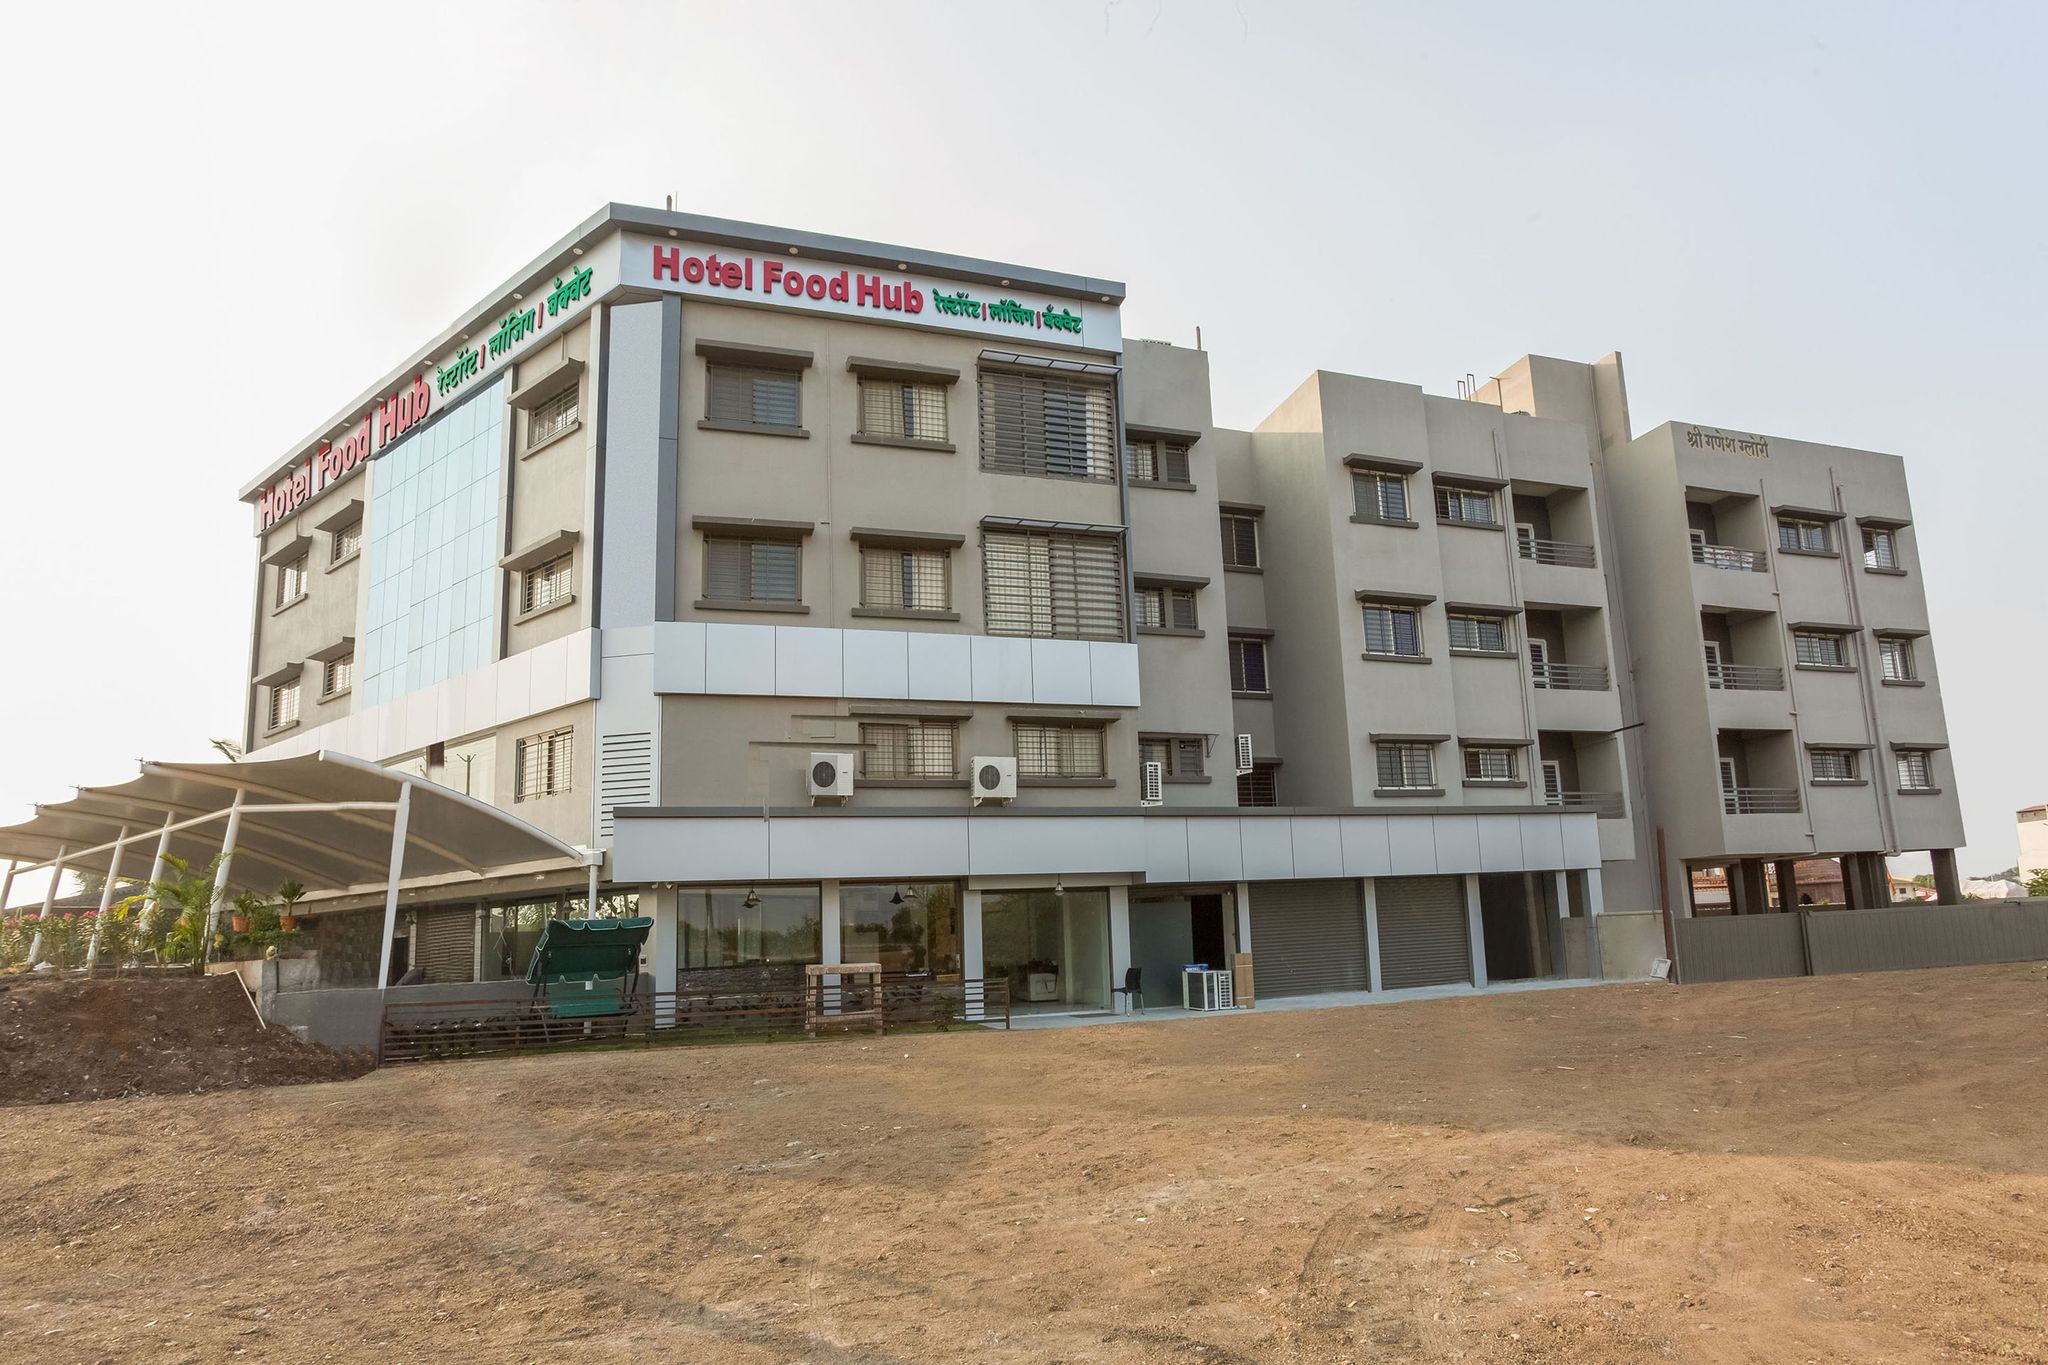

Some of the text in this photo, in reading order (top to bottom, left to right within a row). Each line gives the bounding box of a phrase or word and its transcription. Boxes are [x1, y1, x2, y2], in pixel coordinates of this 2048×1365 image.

[653, 245, 924, 314] Hotel Food Hub
[258, 374, 430, 532] Hotel Food Hub
[1687, 425, 1769, 458] श्री गणेश ग्लोरी
